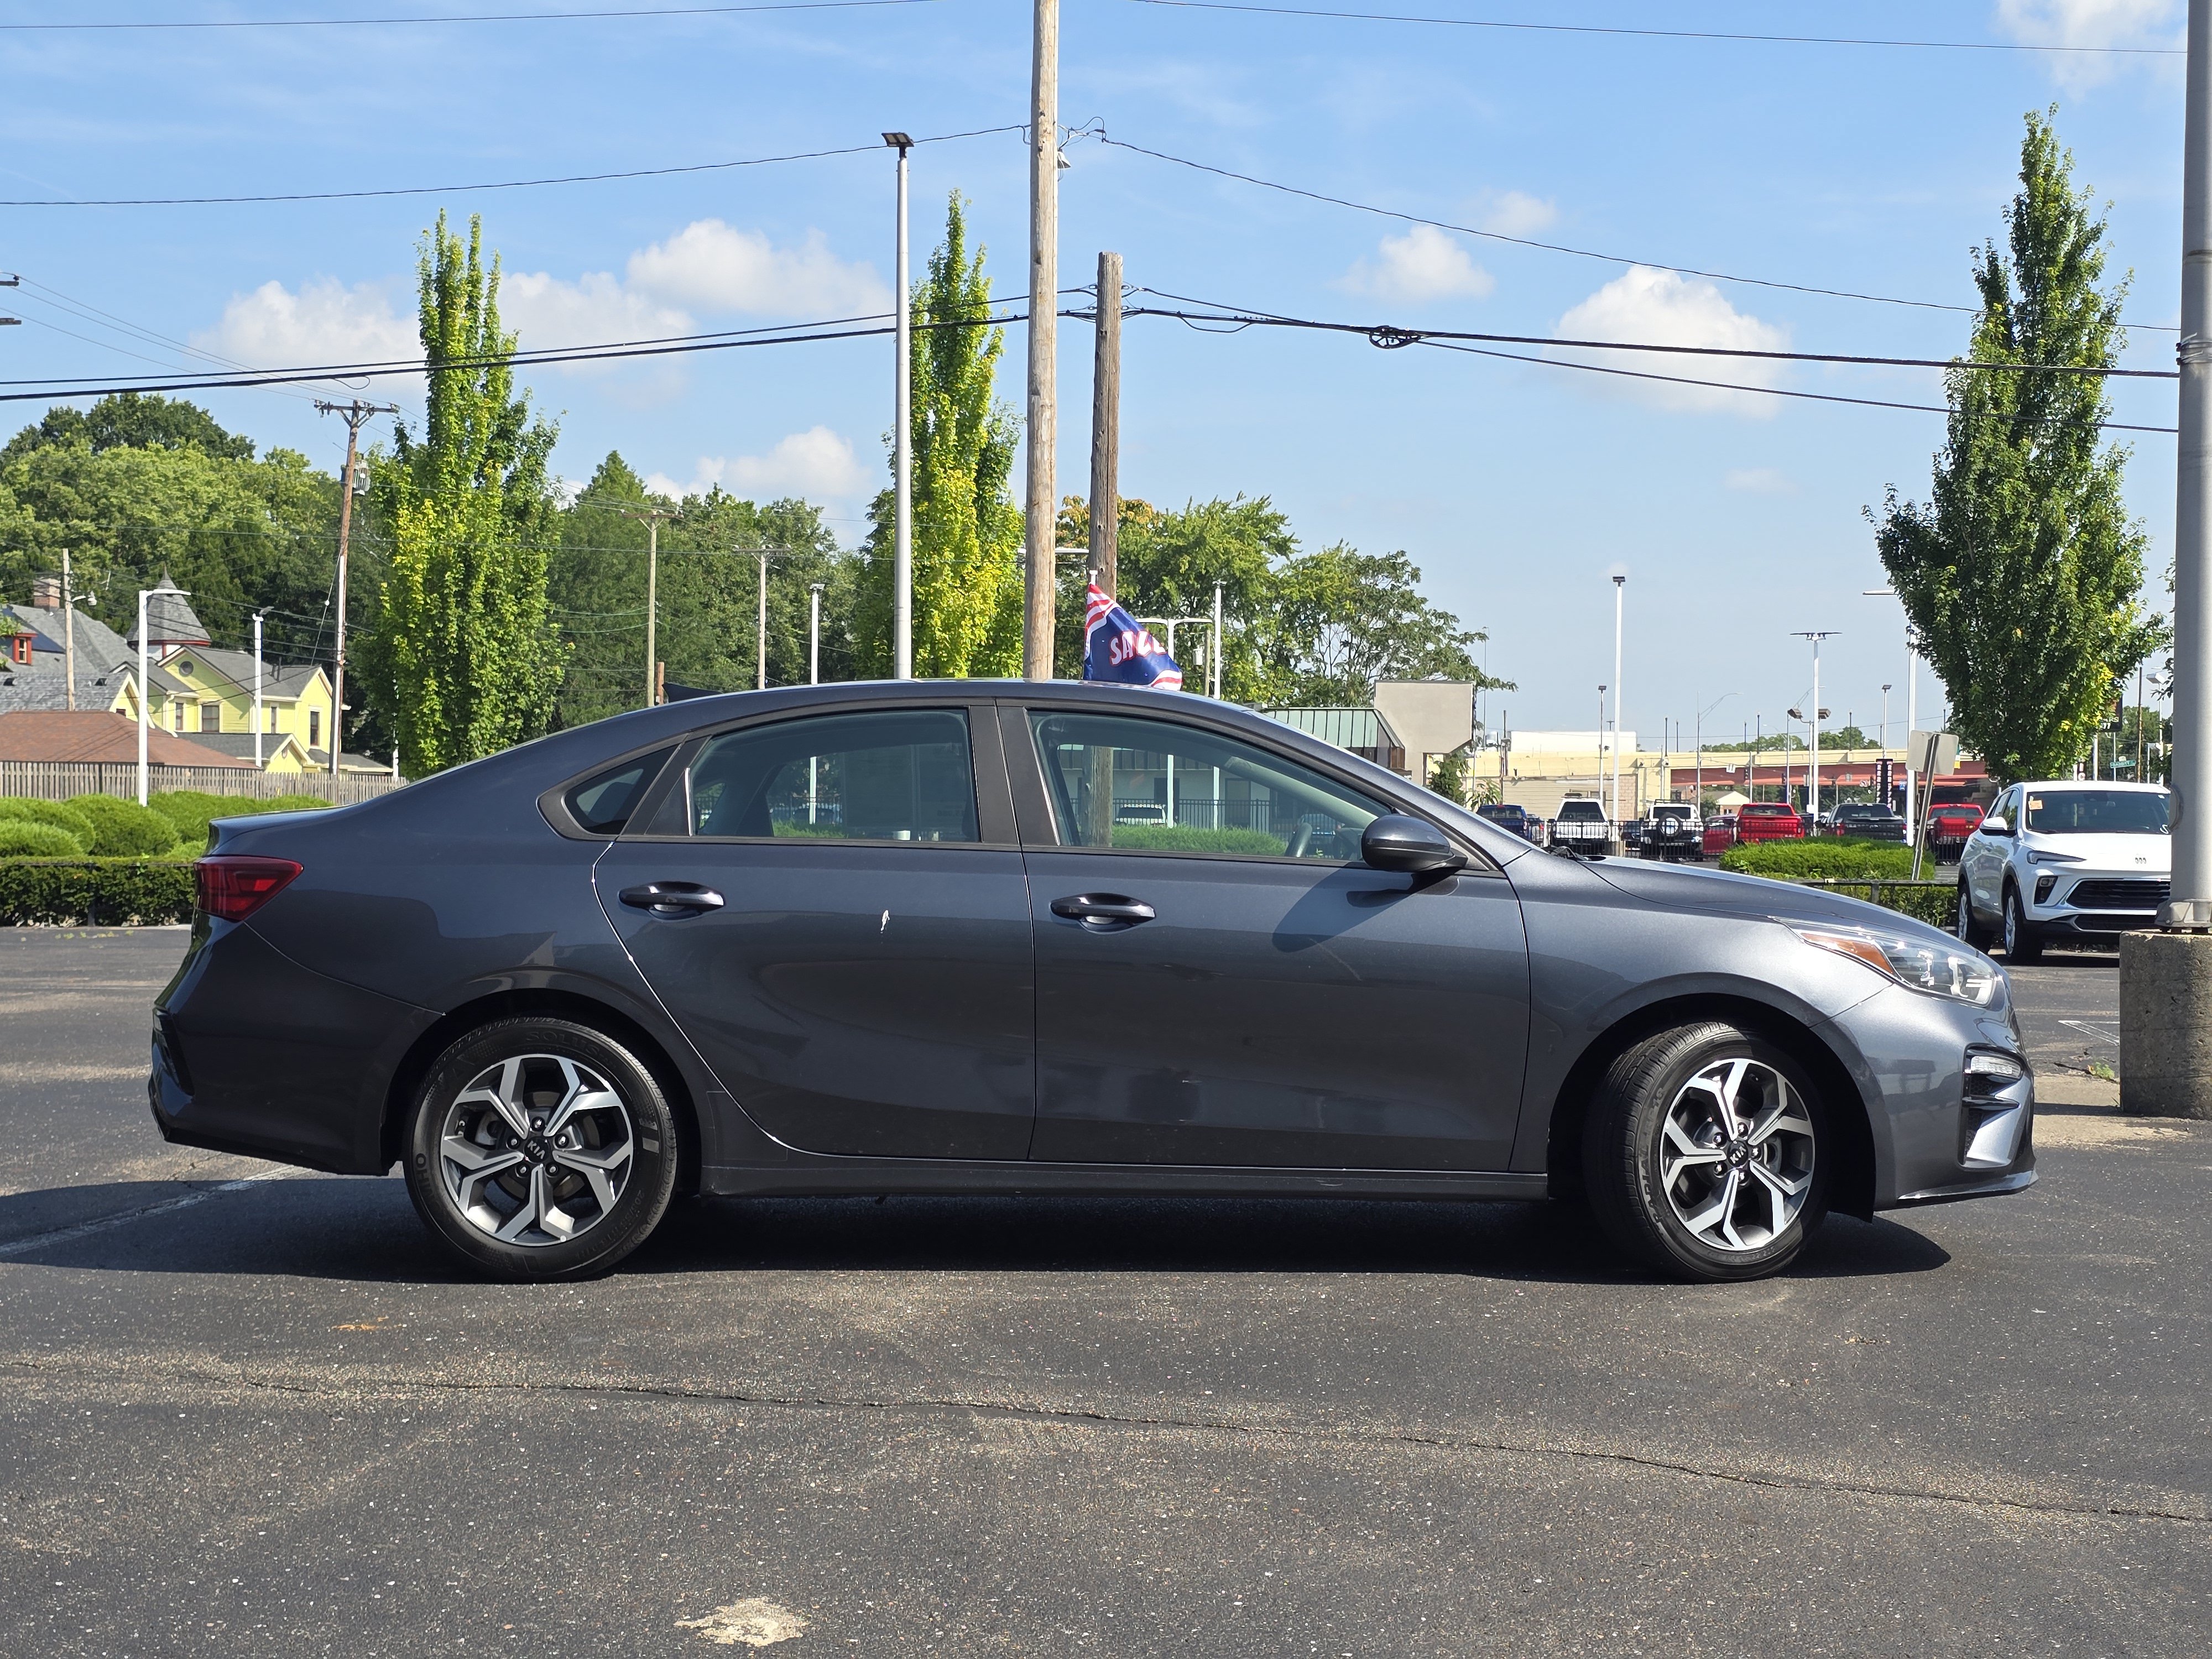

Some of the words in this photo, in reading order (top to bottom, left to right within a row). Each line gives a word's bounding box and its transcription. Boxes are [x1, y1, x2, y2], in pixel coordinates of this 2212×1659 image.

[525, 1030, 601, 1056] SOLUS
[527, 1140, 545, 1160] KIA
[1730, 1146, 1746, 1164] KIA
